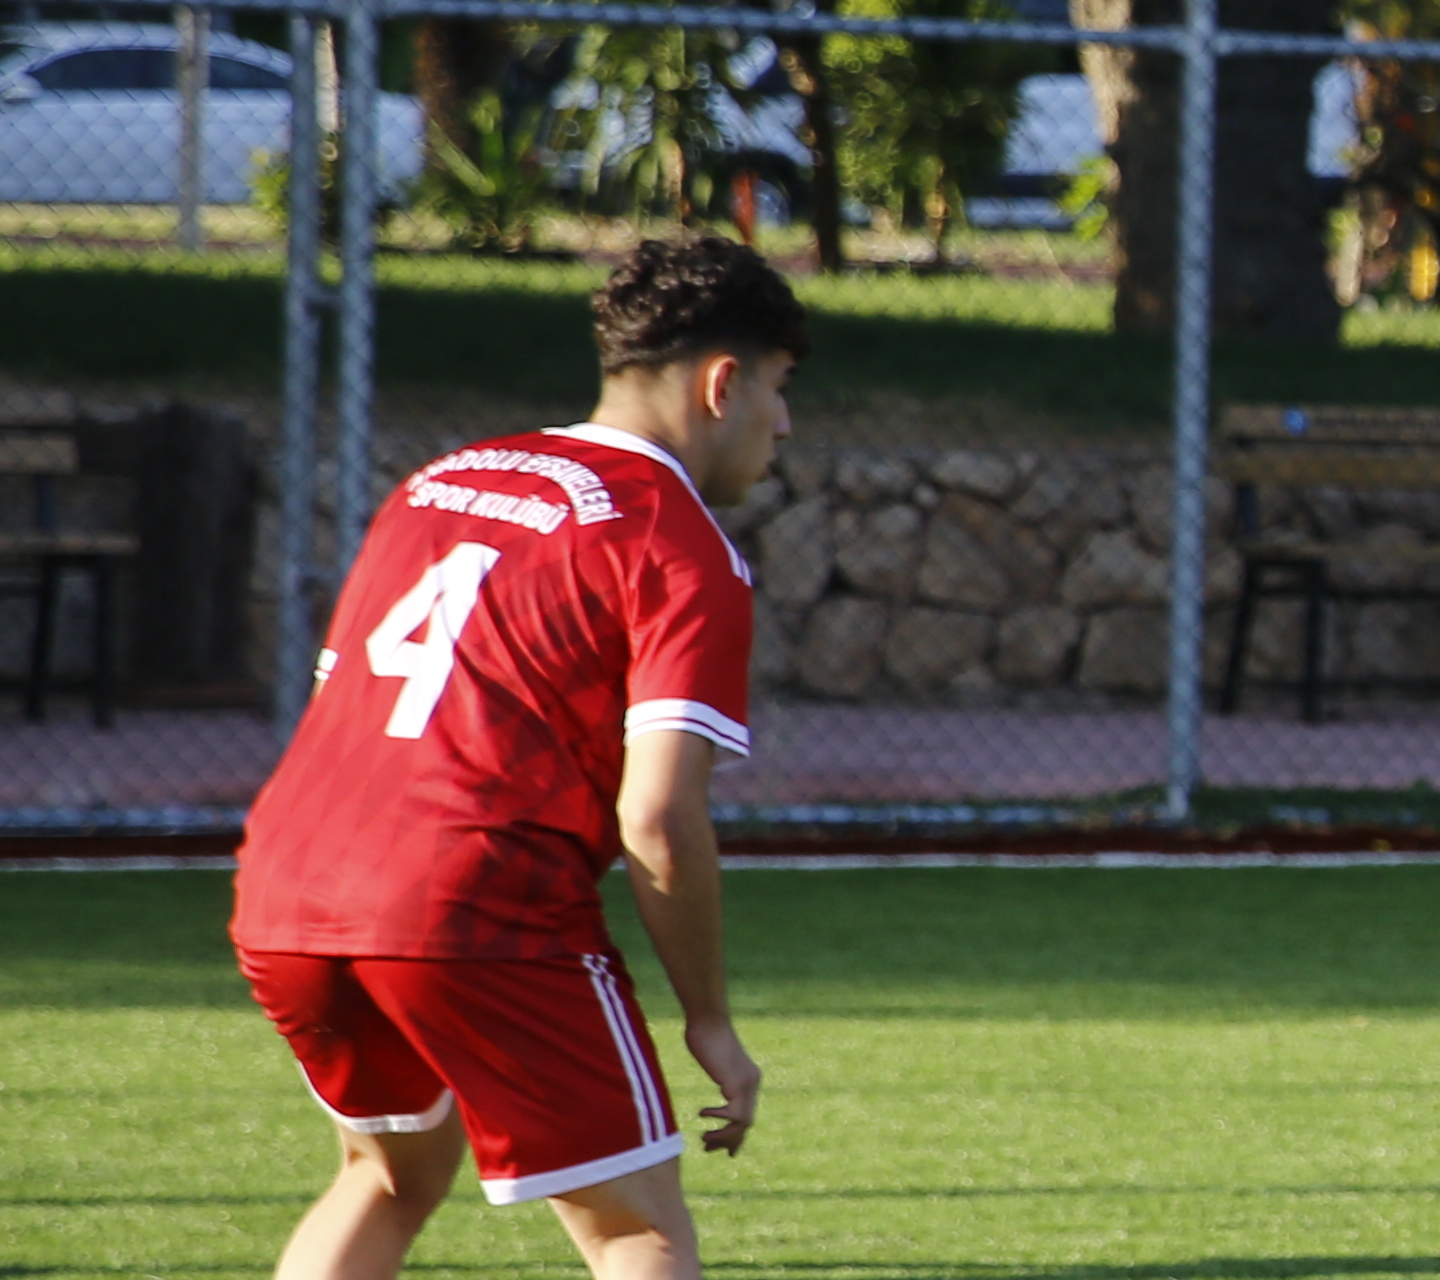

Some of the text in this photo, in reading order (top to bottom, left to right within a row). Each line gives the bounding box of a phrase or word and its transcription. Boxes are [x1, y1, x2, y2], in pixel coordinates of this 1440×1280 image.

[406, 479, 572, 536] SPOR KULÜBÜ
[365, 541, 501, 740] 4
